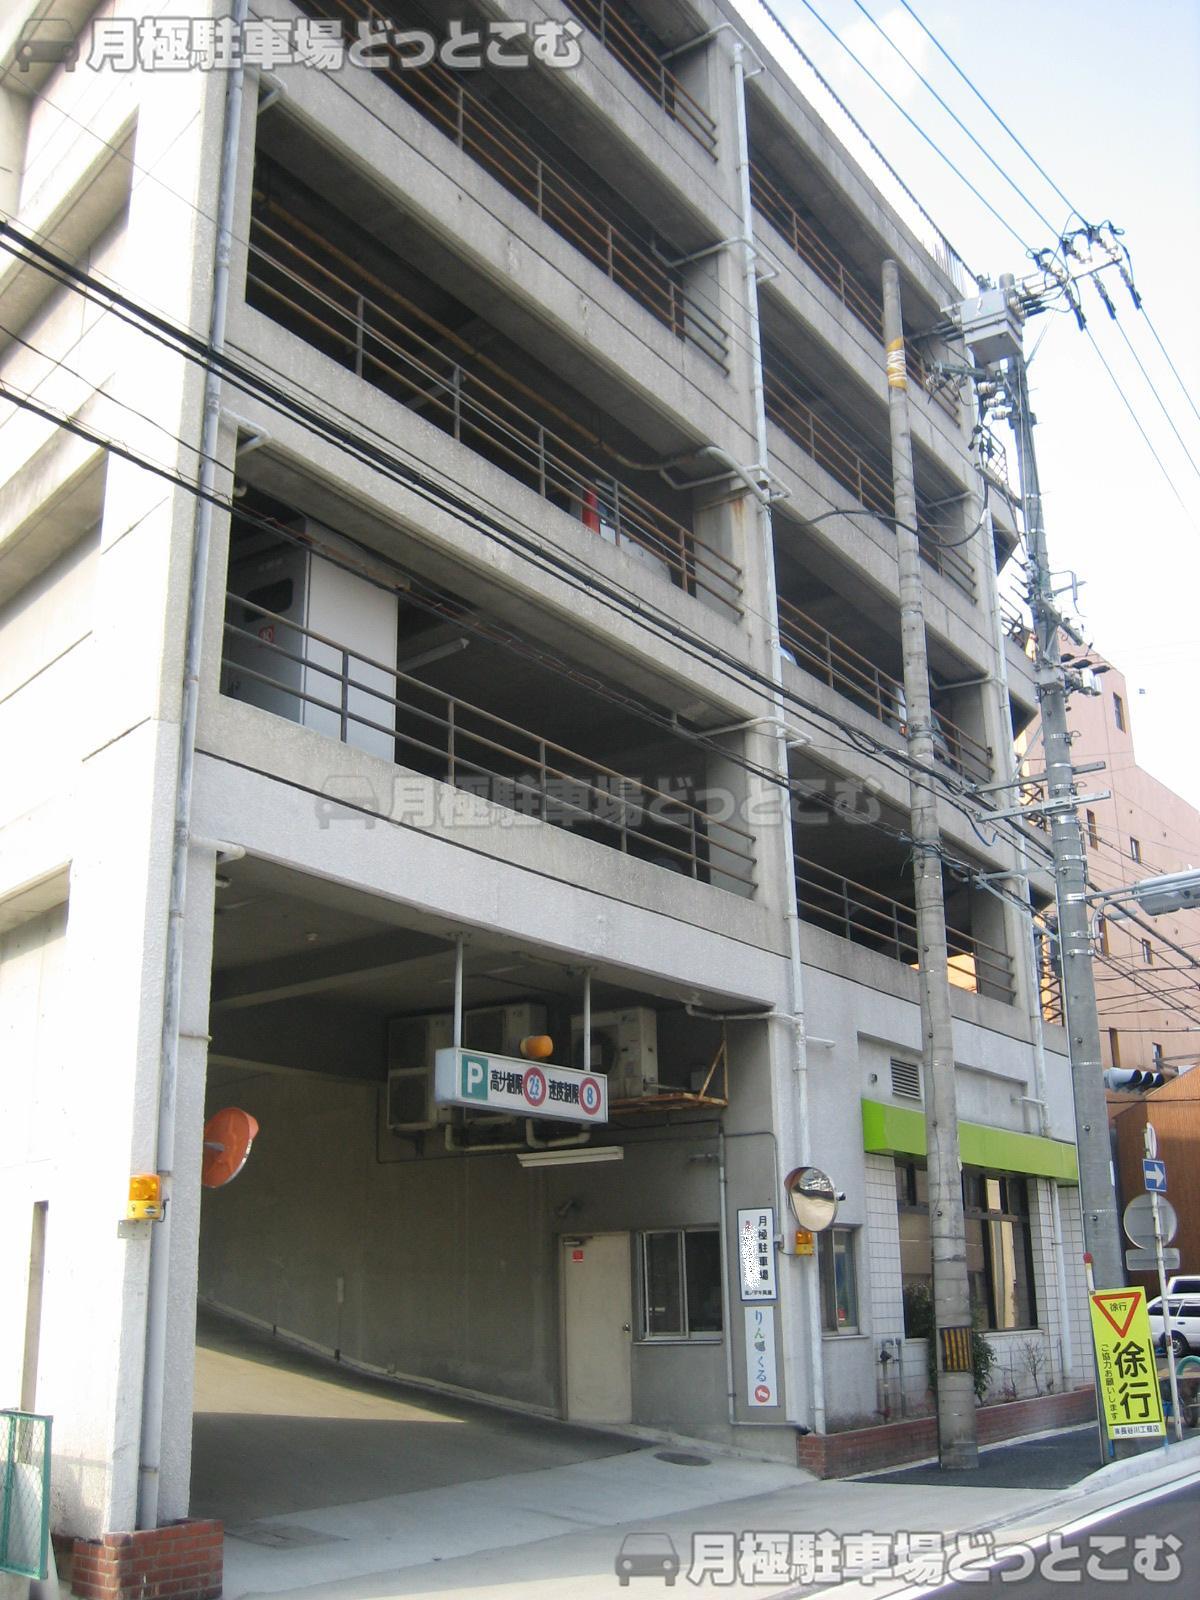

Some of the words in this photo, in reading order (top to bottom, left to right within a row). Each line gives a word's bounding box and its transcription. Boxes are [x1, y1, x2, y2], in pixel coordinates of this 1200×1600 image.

[467, 1061, 484, 1094] P
[548, 1079, 580, 1105] 速度制限
[586, 1087, 594, 1105] 8
[758, 1215, 769, 1281] 月極駐車場
[1109, 1301, 1127, 1313] 徐行
[1101, 1343, 1119, 1420] ご協力お願いします
[1112, 1340, 1152, 1420] 徐行
